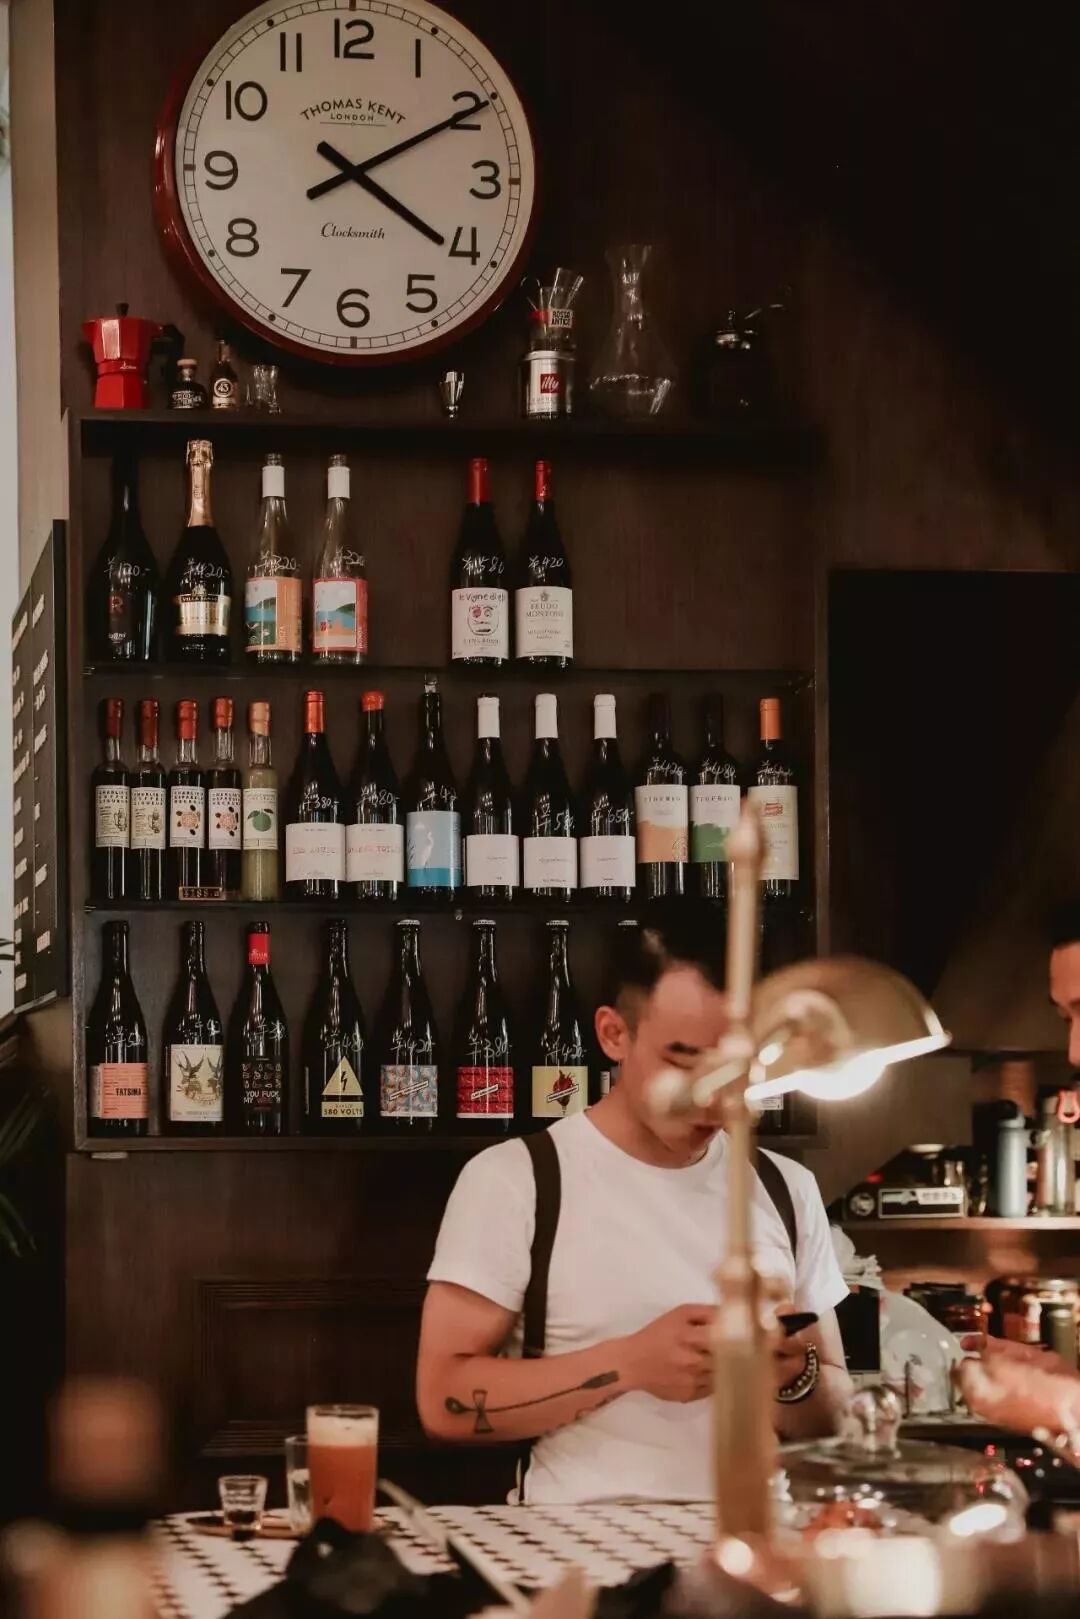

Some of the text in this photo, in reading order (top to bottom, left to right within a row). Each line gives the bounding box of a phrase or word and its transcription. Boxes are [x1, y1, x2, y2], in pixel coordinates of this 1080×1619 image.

[280, 32, 302, 72] 11
[334, 18, 375, 59] 12
[415, 38, 421, 78] 1
[225, 80, 268, 122] 10
[300, 98, 406, 125] THOMAS KENT
[330, 113, 375, 122] LONDON
[450, 91, 481, 130] 2
[204, 151, 239, 191] 9
[469, 160, 501, 200] 3
[225, 217, 260, 258] 8
[319, 221, 386, 240] Clocksmith
[448, 226, 481, 265] 4
[280, 267, 312, 308] 7
[405, 273, 438, 313] 5
[336, 288, 371, 328] 6
[541, 375, 560, 392] illy
